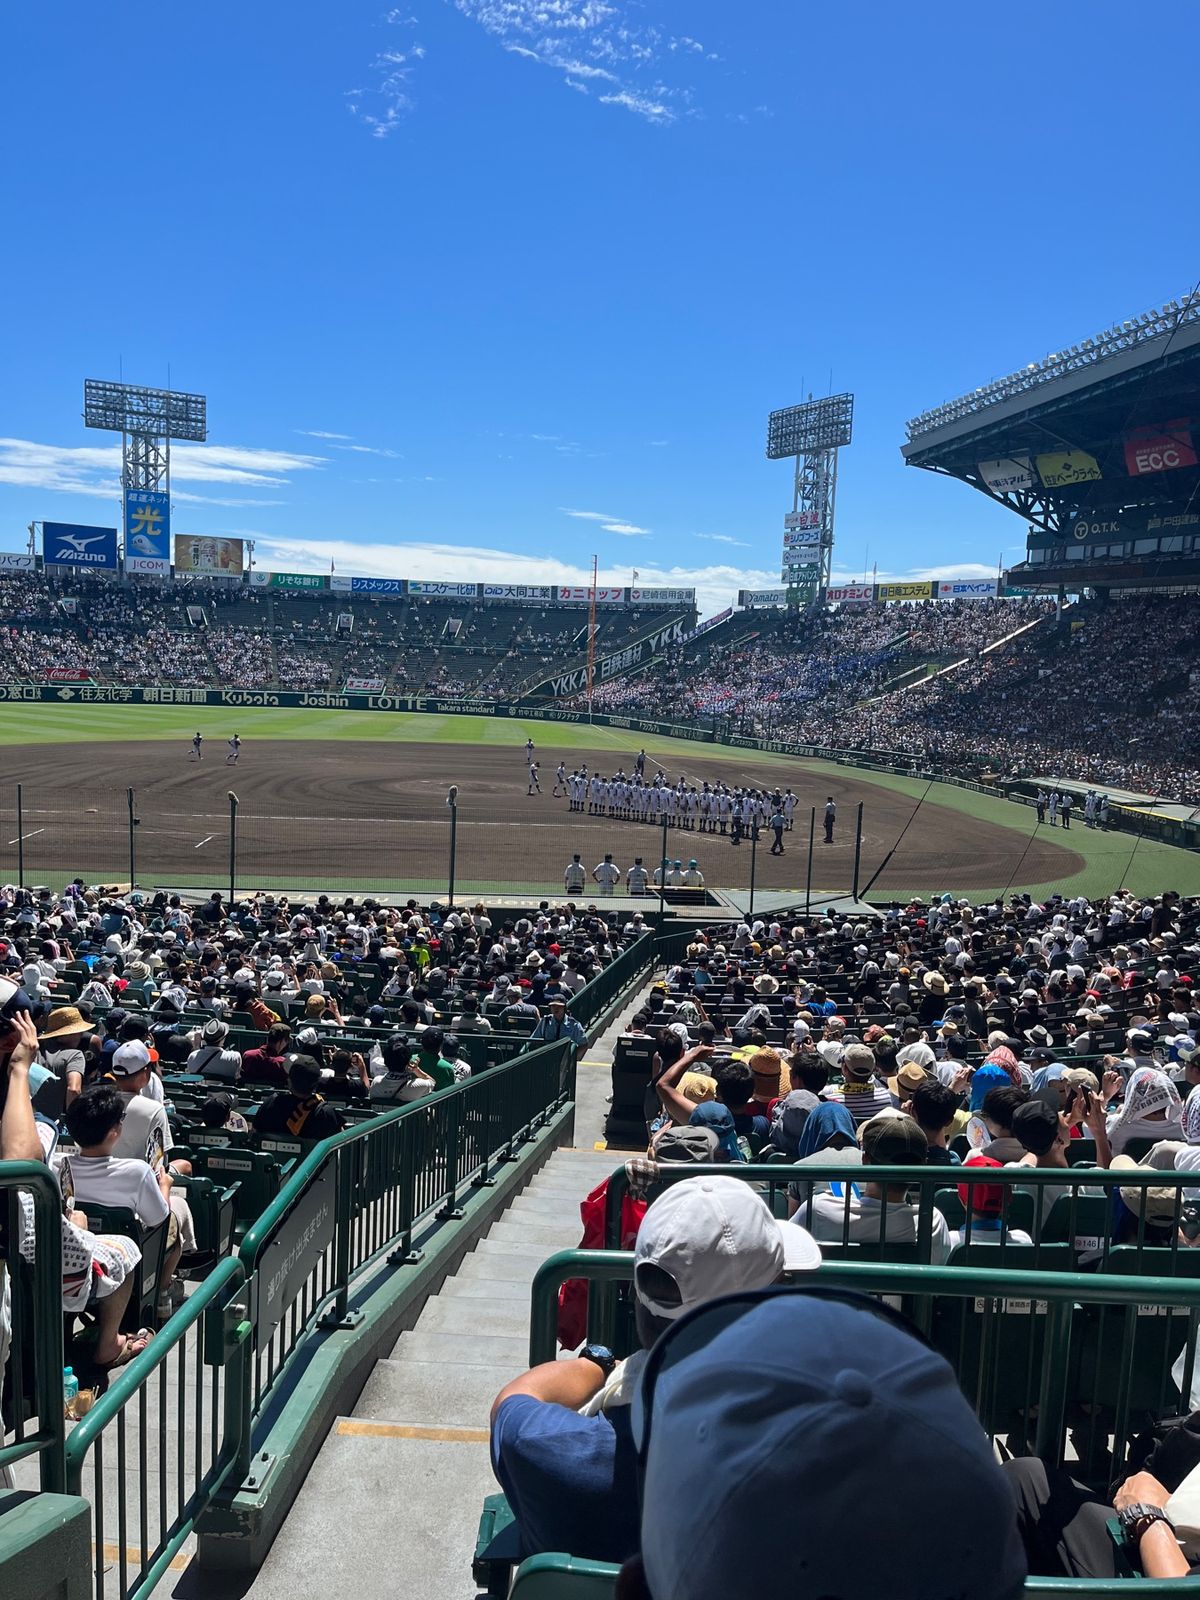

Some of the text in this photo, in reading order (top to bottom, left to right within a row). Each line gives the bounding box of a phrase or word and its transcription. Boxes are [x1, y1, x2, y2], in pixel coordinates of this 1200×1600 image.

[1135, 450, 1180, 473] ECC
[129, 504, 166, 536] 光
[1091, 522, 1120, 535] O.T.K.
[277, 575, 320, 587] りそな銀行
[353, 579, 400, 592] シスメックス
[422, 583, 476, 596] エスケー化研
[505, 586, 551, 599] 大同工業
[560, 588, 622, 600] カニトップ
[826, 588, 873, 600] オロナミンC
[952, 583, 996, 594] 日本ペイント
[748, 593, 779, 603] Yamato
[649, 620, 684, 652] YKK
[551, 676, 579, 697] YKK
[79, 688, 133, 702] 住友化学
[142, 689, 208, 703] 朝日新聞
[221, 691, 280, 707] Kubota
[299, 692, 350, 708] Joshin
[368, 697, 428, 711] LOTTE
[436, 703, 462, 712] Takara
[462, 704, 496, 714] standard
[1082, 1240, 1096, 1249] 146
